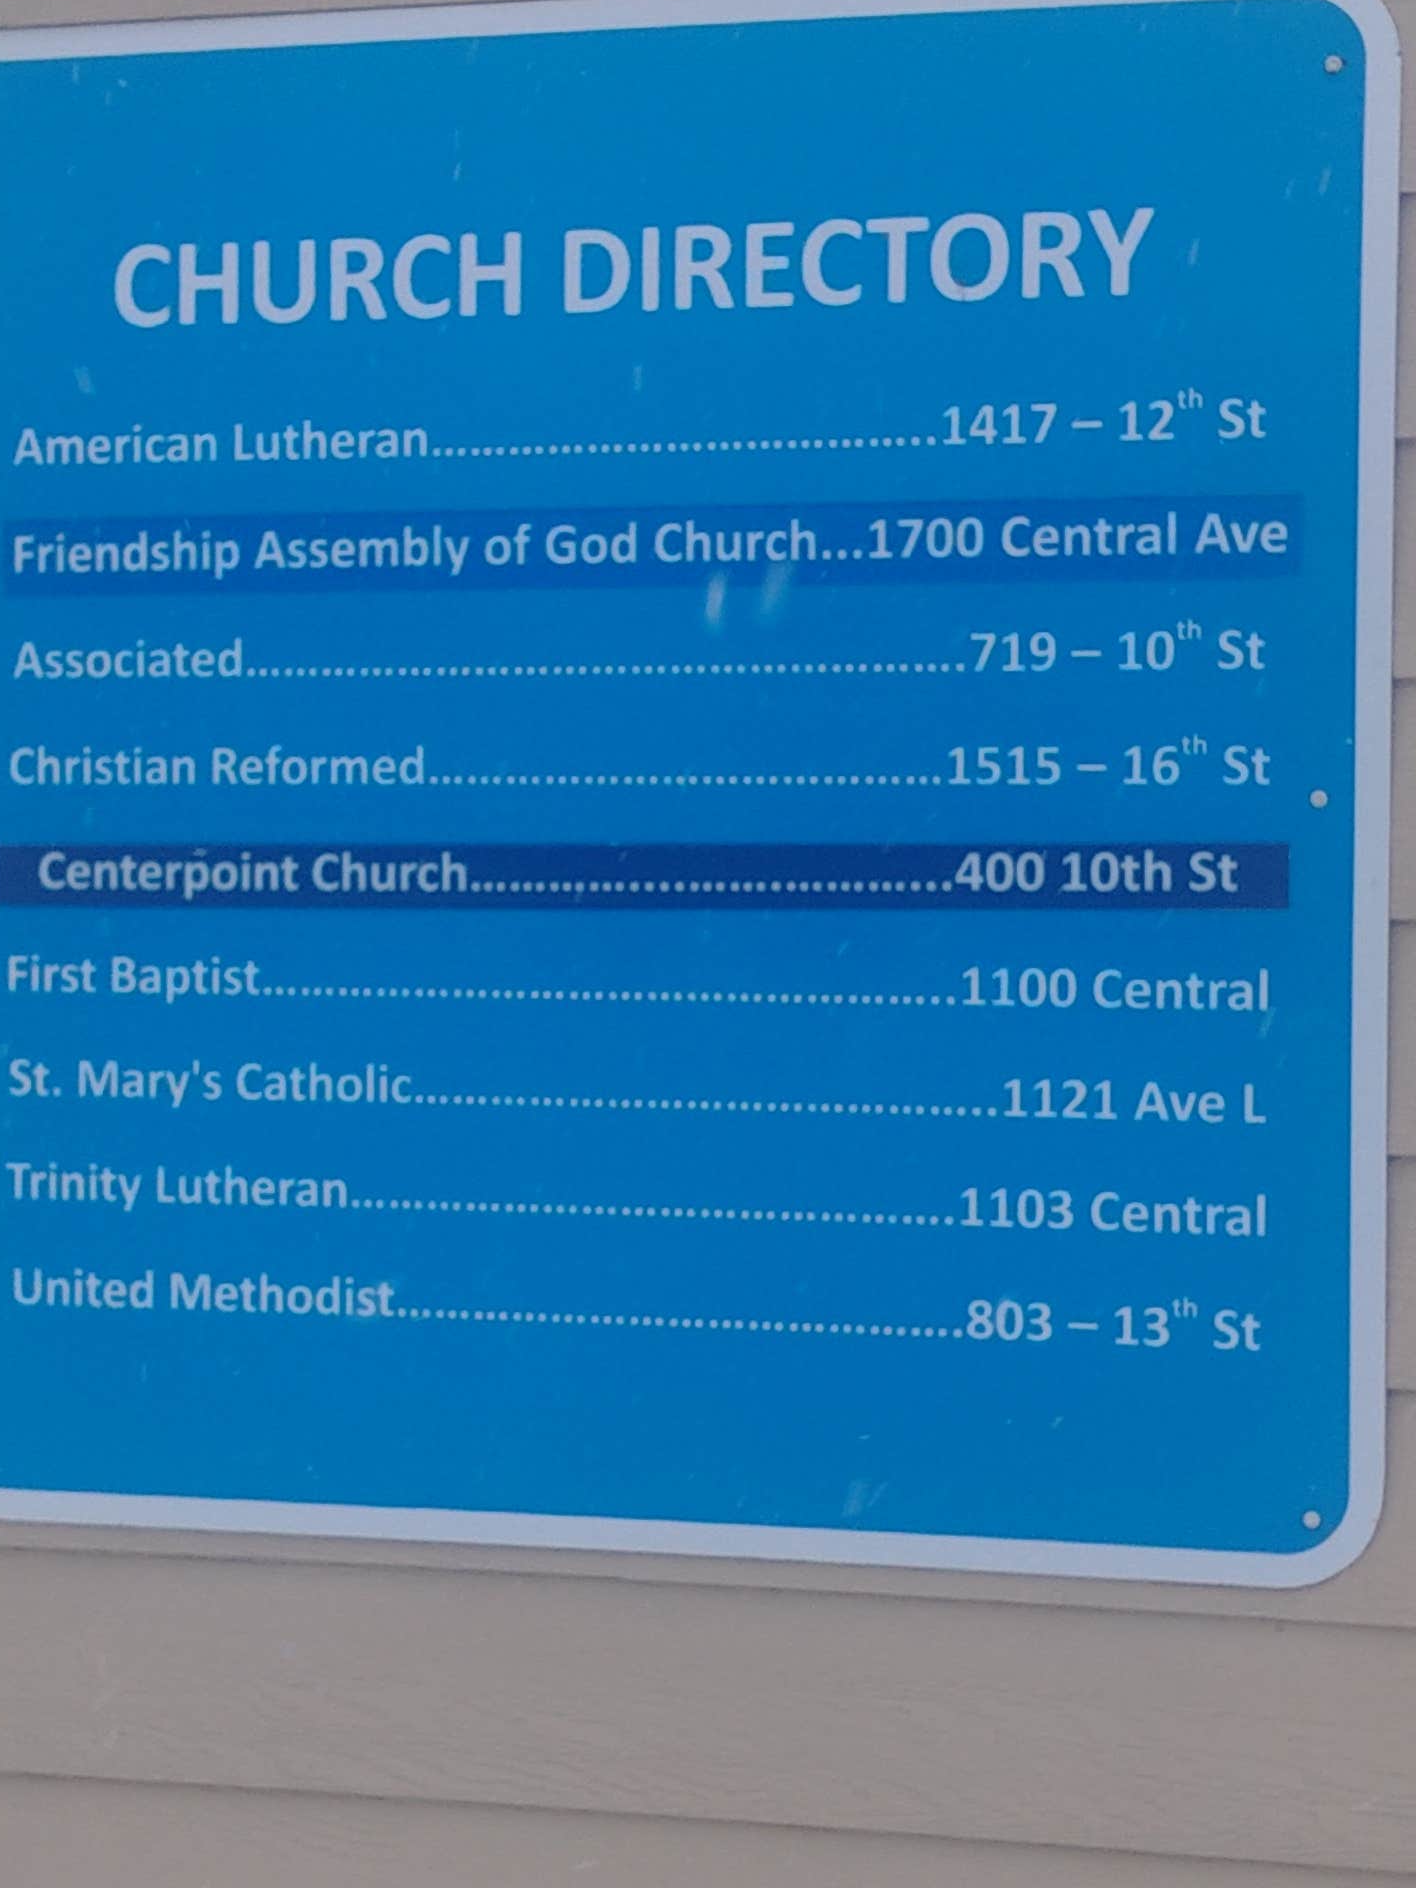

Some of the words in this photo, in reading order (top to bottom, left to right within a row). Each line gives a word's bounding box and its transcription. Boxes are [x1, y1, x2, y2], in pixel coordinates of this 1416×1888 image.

[114, 231, 522, 328] CHURCH
[563, 207, 1154, 313] DIRECTORY
[14, 422, 217, 465] American
[234, 419, 428, 461] Lutheran
[943, 403, 1057, 445] 1417
[1218, 398, 1266, 439] St
[13, 530, 240, 579] Friendship
[254, 525, 469, 575] Assembly
[484, 523, 531, 565] of
[545, 521, 637, 565] God
[654, 518, 816, 562] Church
[869, 516, 984, 559] 1700
[1001, 511, 1177, 557] Central
[1195, 513, 1288, 554] Ave
[13, 638, 242, 679] Associated
[970, 631, 1057, 672] 719
[1217, 629, 1265, 670] St
[9, 745, 196, 785] Christian
[212, 745, 424, 785] Reformed
[949, 746, 1061, 785] 1515
[1223, 745, 1271, 785] St
[38, 851, 299, 900] Centerpoint
[312, 851, 467, 893] Church
[955, 851, 1045, 892] 400
[1062, 849, 1172, 892] 10th
[1189, 851, 1238, 892] St
[7, 955, 95, 993] First
[111, 955, 260, 1004] Baptist
[963, 967, 1077, 1008] 1100
[1093, 968, 1269, 1011] Central
[9, 1058, 62, 1097] St.
[78, 1059, 222, 1108] Mary's
[236, 1062, 411, 1104] Catholic
[1004, 1079, 1117, 1120] 1121
[1135, 1081, 1225, 1123] Ave
[1244, 1083, 1267, 1124] L
[5, 1162, 141, 1212] Trinity
[156, 1166, 347, 1208] Lutheran
[961, 1187, 1074, 1229] 1103
[1090, 1191, 1266, 1237] Central
[13, 1268, 154, 1309] United
[170, 1272, 395, 1318] Methodist
[966, 1299, 1052, 1342] 803
[1213, 1309, 1261, 1351] St
